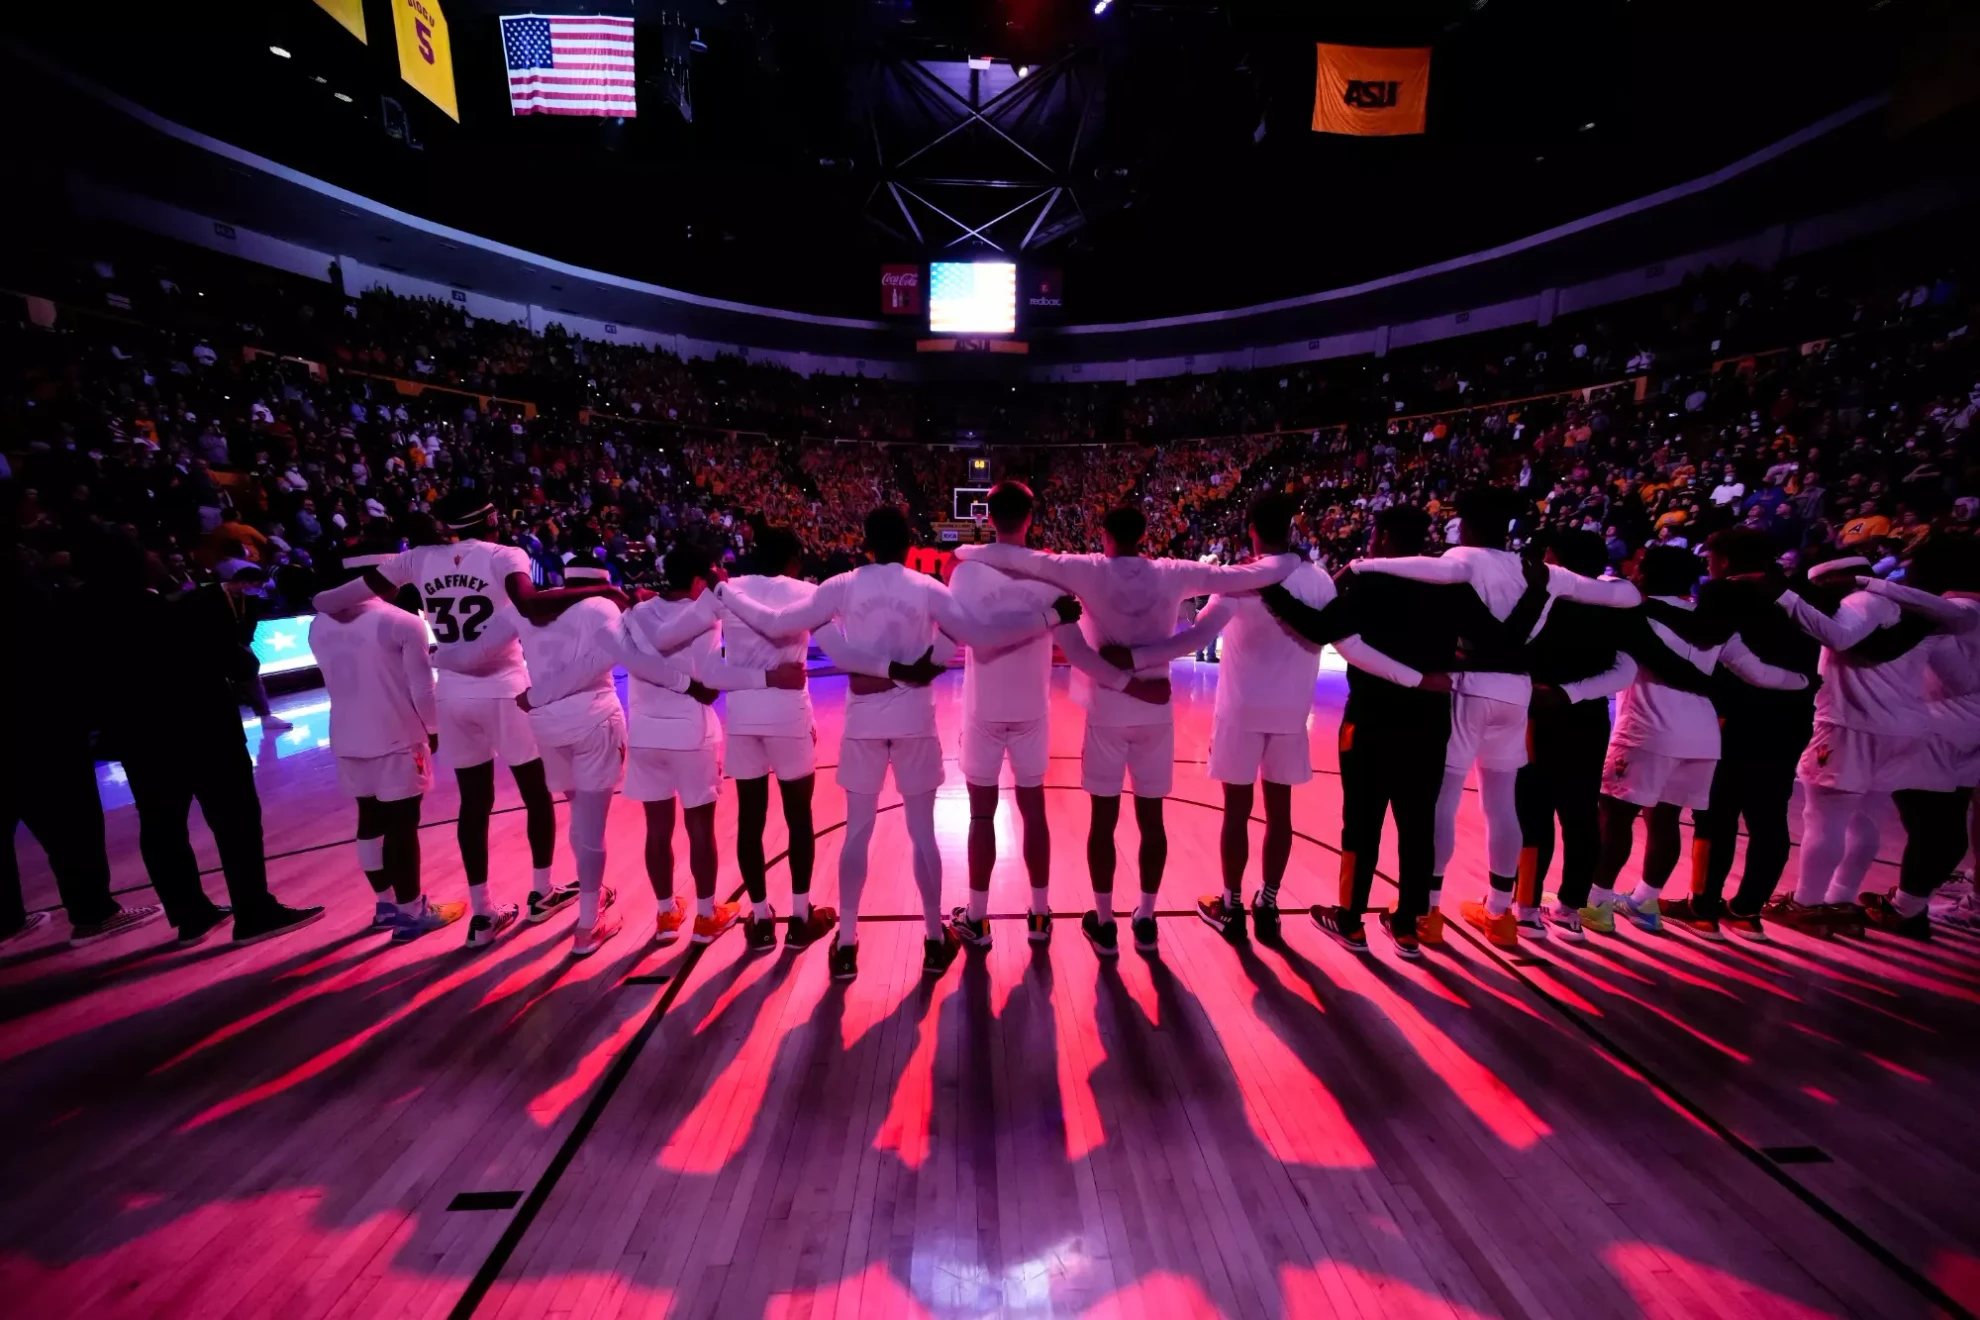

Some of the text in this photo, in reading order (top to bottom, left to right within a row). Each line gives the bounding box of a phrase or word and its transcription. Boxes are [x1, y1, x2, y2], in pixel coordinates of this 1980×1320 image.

[415, 17, 435, 65] 5
[1344, 80, 1400, 108] ASU
[424, 574, 488, 595] GAFFNEY
[426, 595, 494, 643] 32
